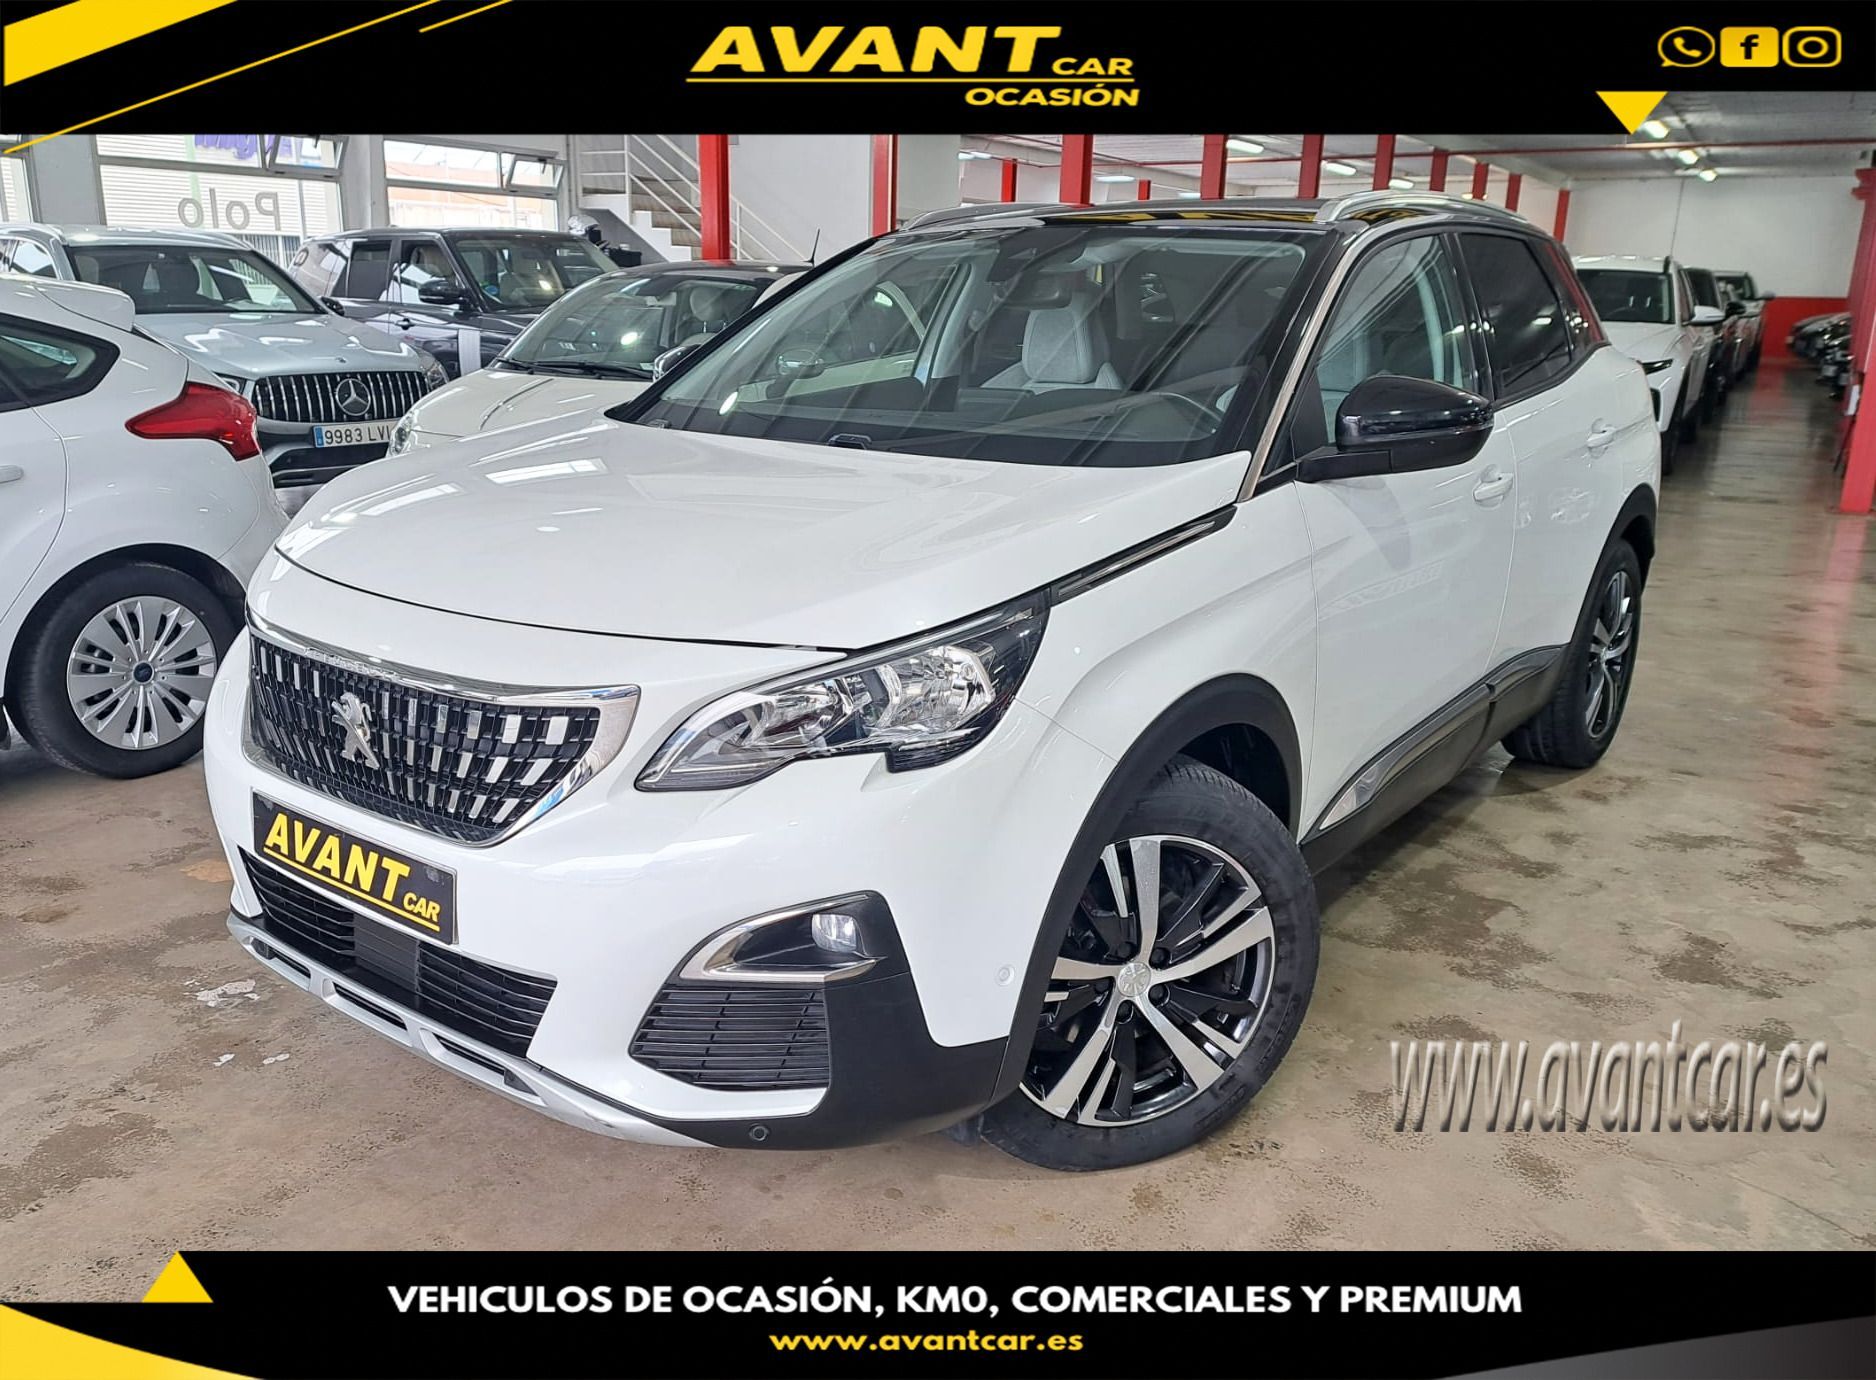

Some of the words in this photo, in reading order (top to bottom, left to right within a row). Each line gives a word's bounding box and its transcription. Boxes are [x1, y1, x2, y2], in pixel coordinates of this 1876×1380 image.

[324, 428, 363, 445] 9983
[264, 813, 410, 902] AVANT
[403, 892, 441, 922] CAR
